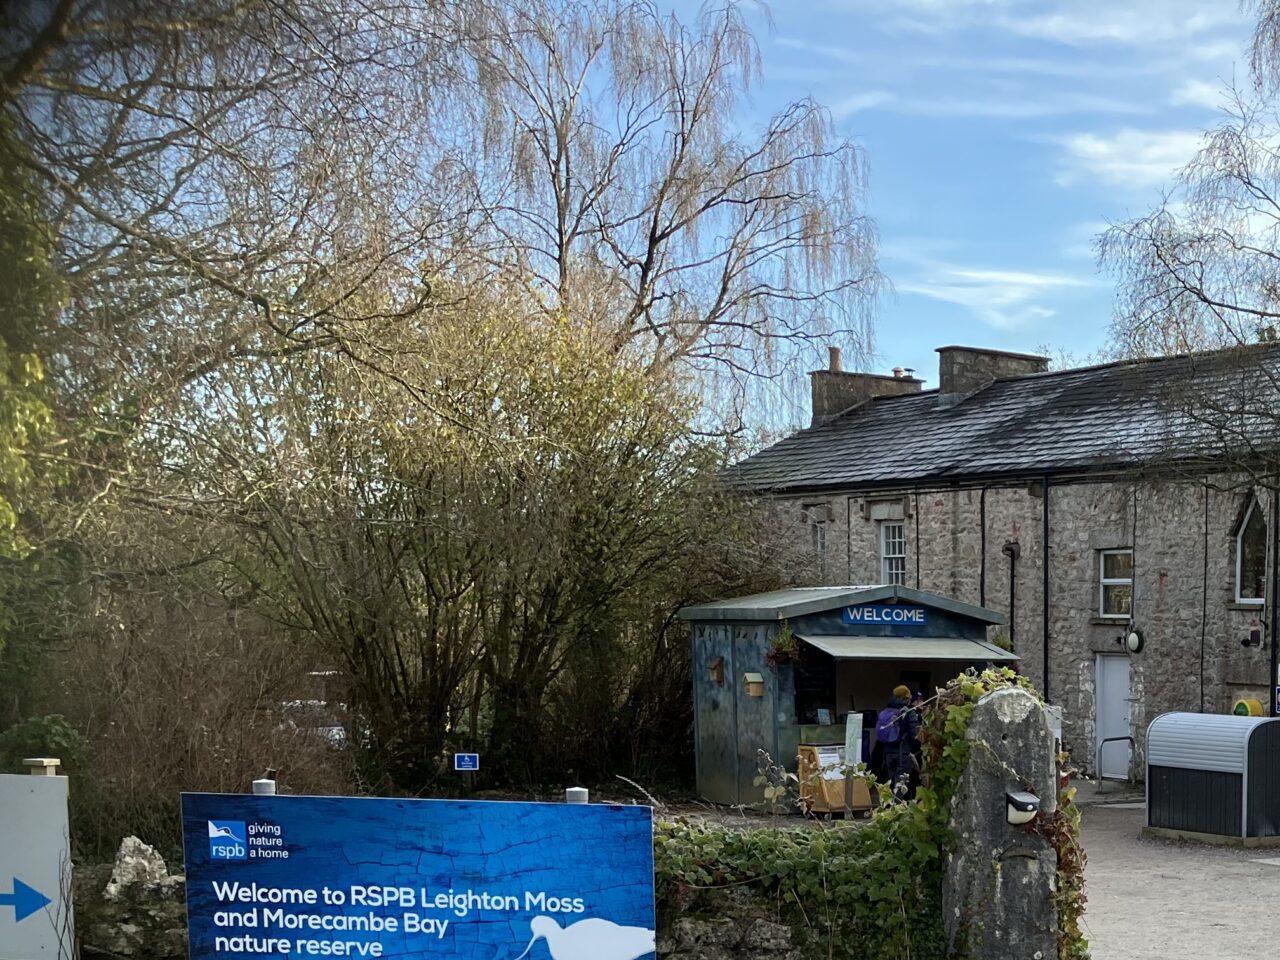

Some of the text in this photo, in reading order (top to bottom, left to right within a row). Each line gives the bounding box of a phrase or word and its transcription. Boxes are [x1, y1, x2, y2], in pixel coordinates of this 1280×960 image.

[847, 607, 925, 622] WELCOME
[248, 823, 281, 836] giving
[249, 836, 283, 847] nature
[212, 843, 245, 860] rspb
[249, 848, 289, 859] a home
[212, 881, 586, 917] Welcome to RSPB Leighton Moss
[213, 907, 449, 939] and Morecambe Bay
[215, 934, 384, 957] nature reserve
